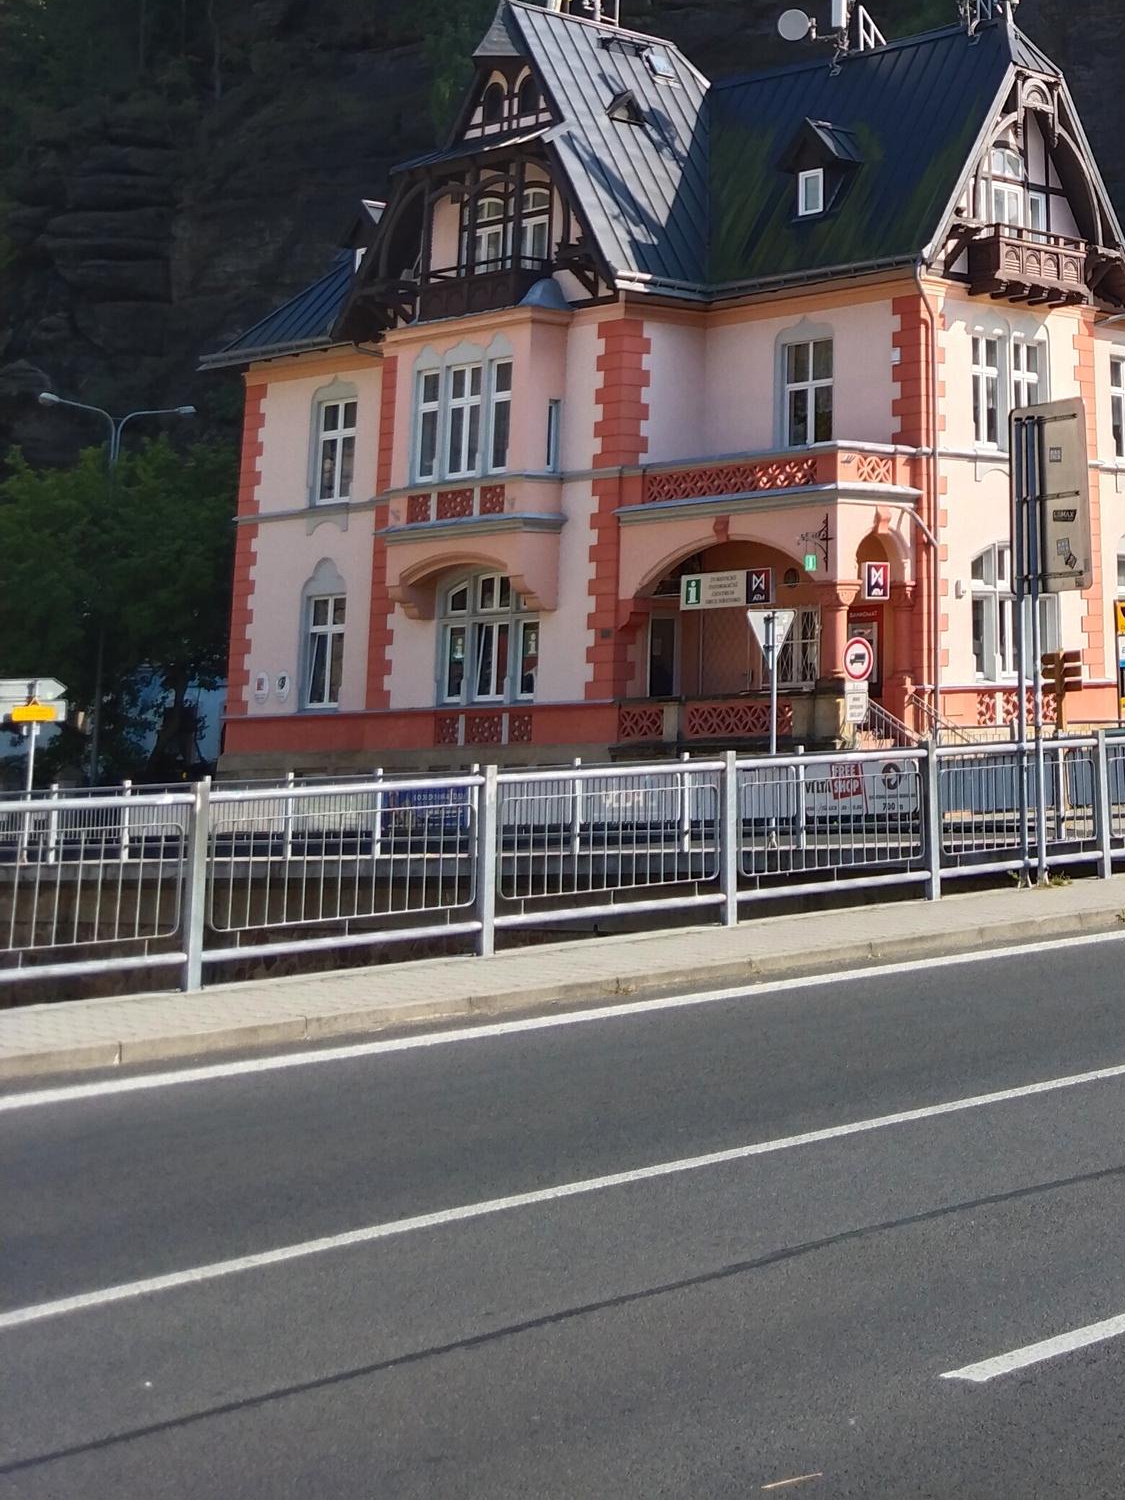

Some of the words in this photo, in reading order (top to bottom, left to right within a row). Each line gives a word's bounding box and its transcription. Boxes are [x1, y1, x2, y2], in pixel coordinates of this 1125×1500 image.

[752, 593, 765, 601] ATM
[832, 764, 858, 777] FREE
[833, 778, 860, 794] SHOP
